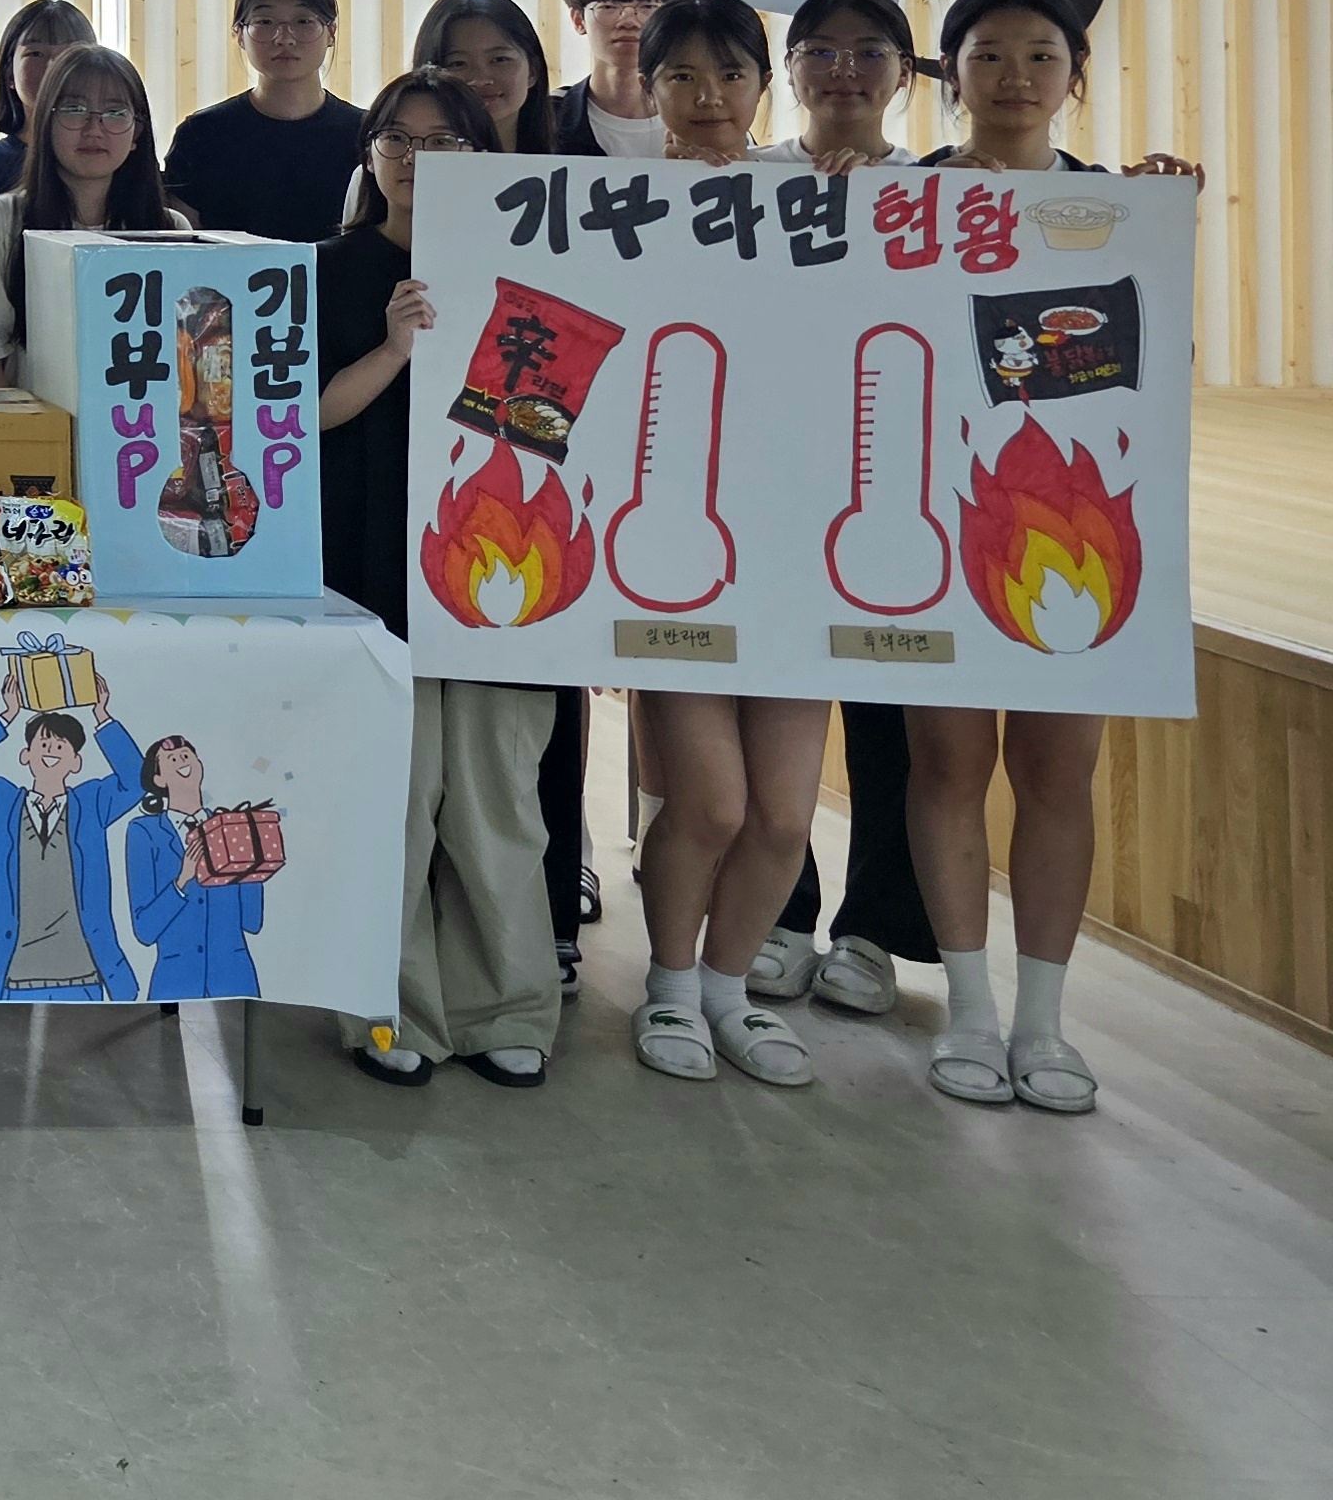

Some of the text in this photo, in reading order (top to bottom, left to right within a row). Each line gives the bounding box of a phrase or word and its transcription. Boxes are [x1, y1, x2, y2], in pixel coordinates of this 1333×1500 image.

[495, 166, 1021, 275] 기부 라면 현황
[105, 269, 171, 400] 기부
[247, 263, 310, 400] 기분
[2, 518, 76, 546] 너구리
[645, 628, 713, 648] 일반라면
